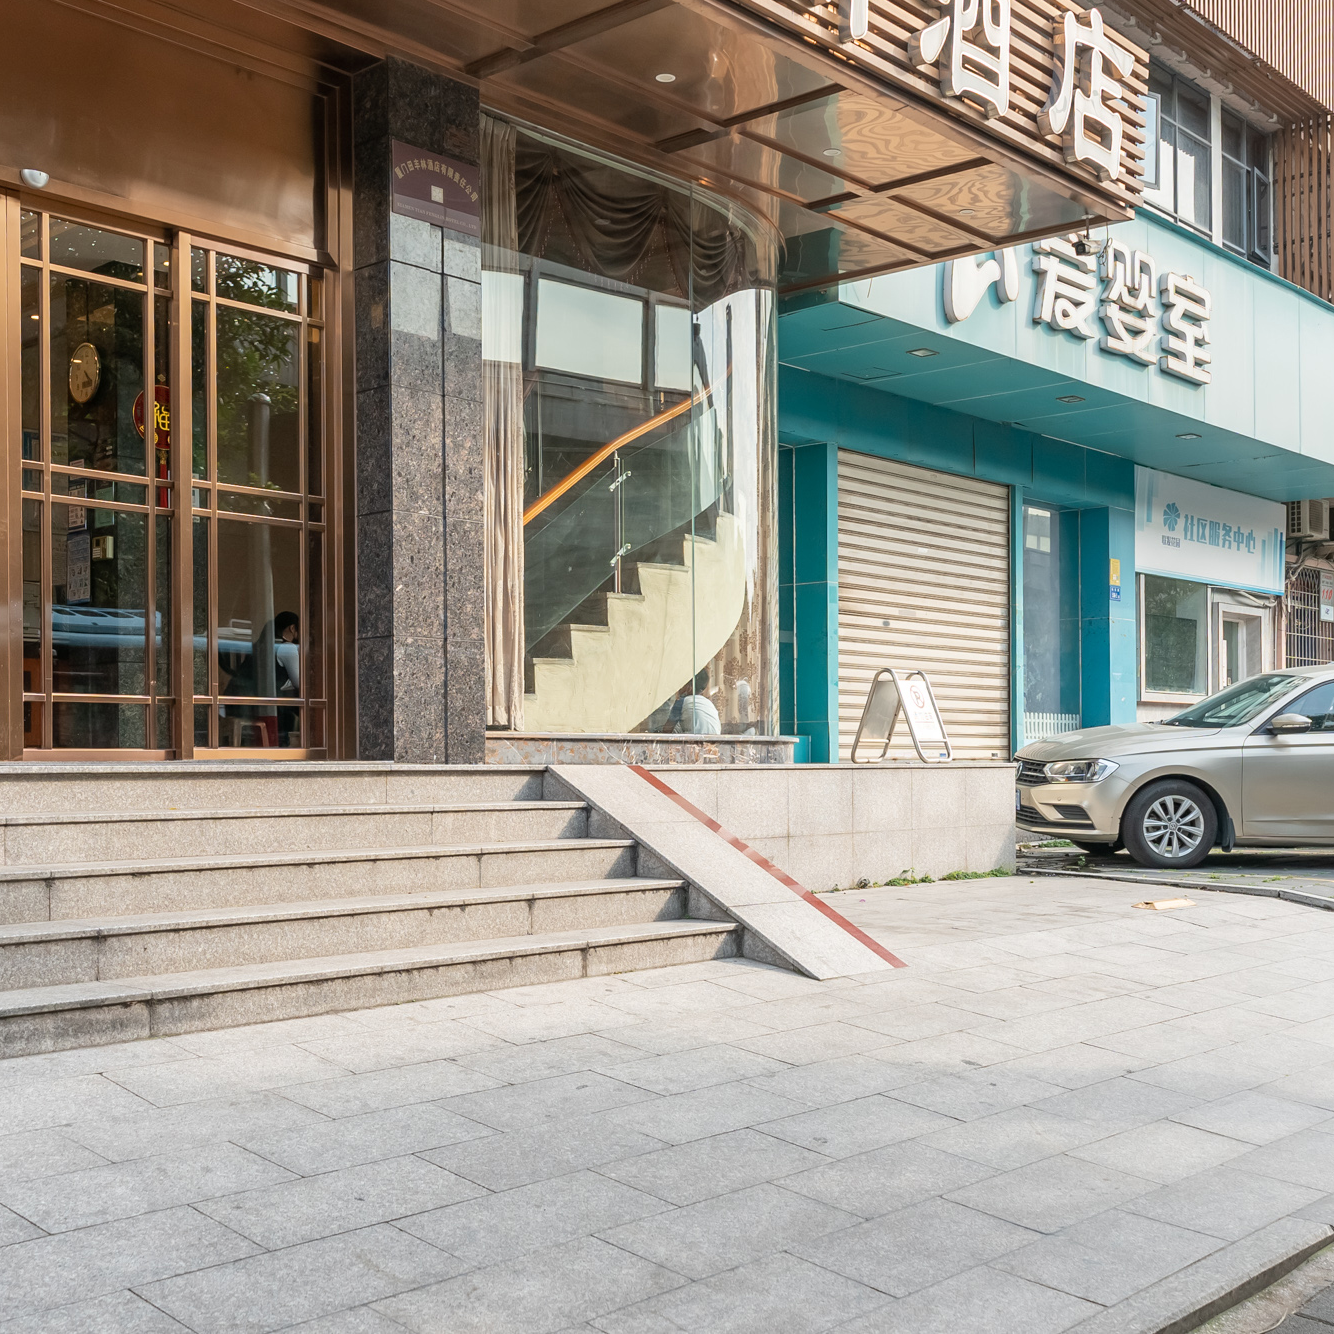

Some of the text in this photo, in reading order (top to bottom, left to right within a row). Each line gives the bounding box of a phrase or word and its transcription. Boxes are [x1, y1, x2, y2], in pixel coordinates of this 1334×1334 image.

[1183, 514, 1256, 554] 社区服务中心
[1321, 588, 1333, 601] 110
